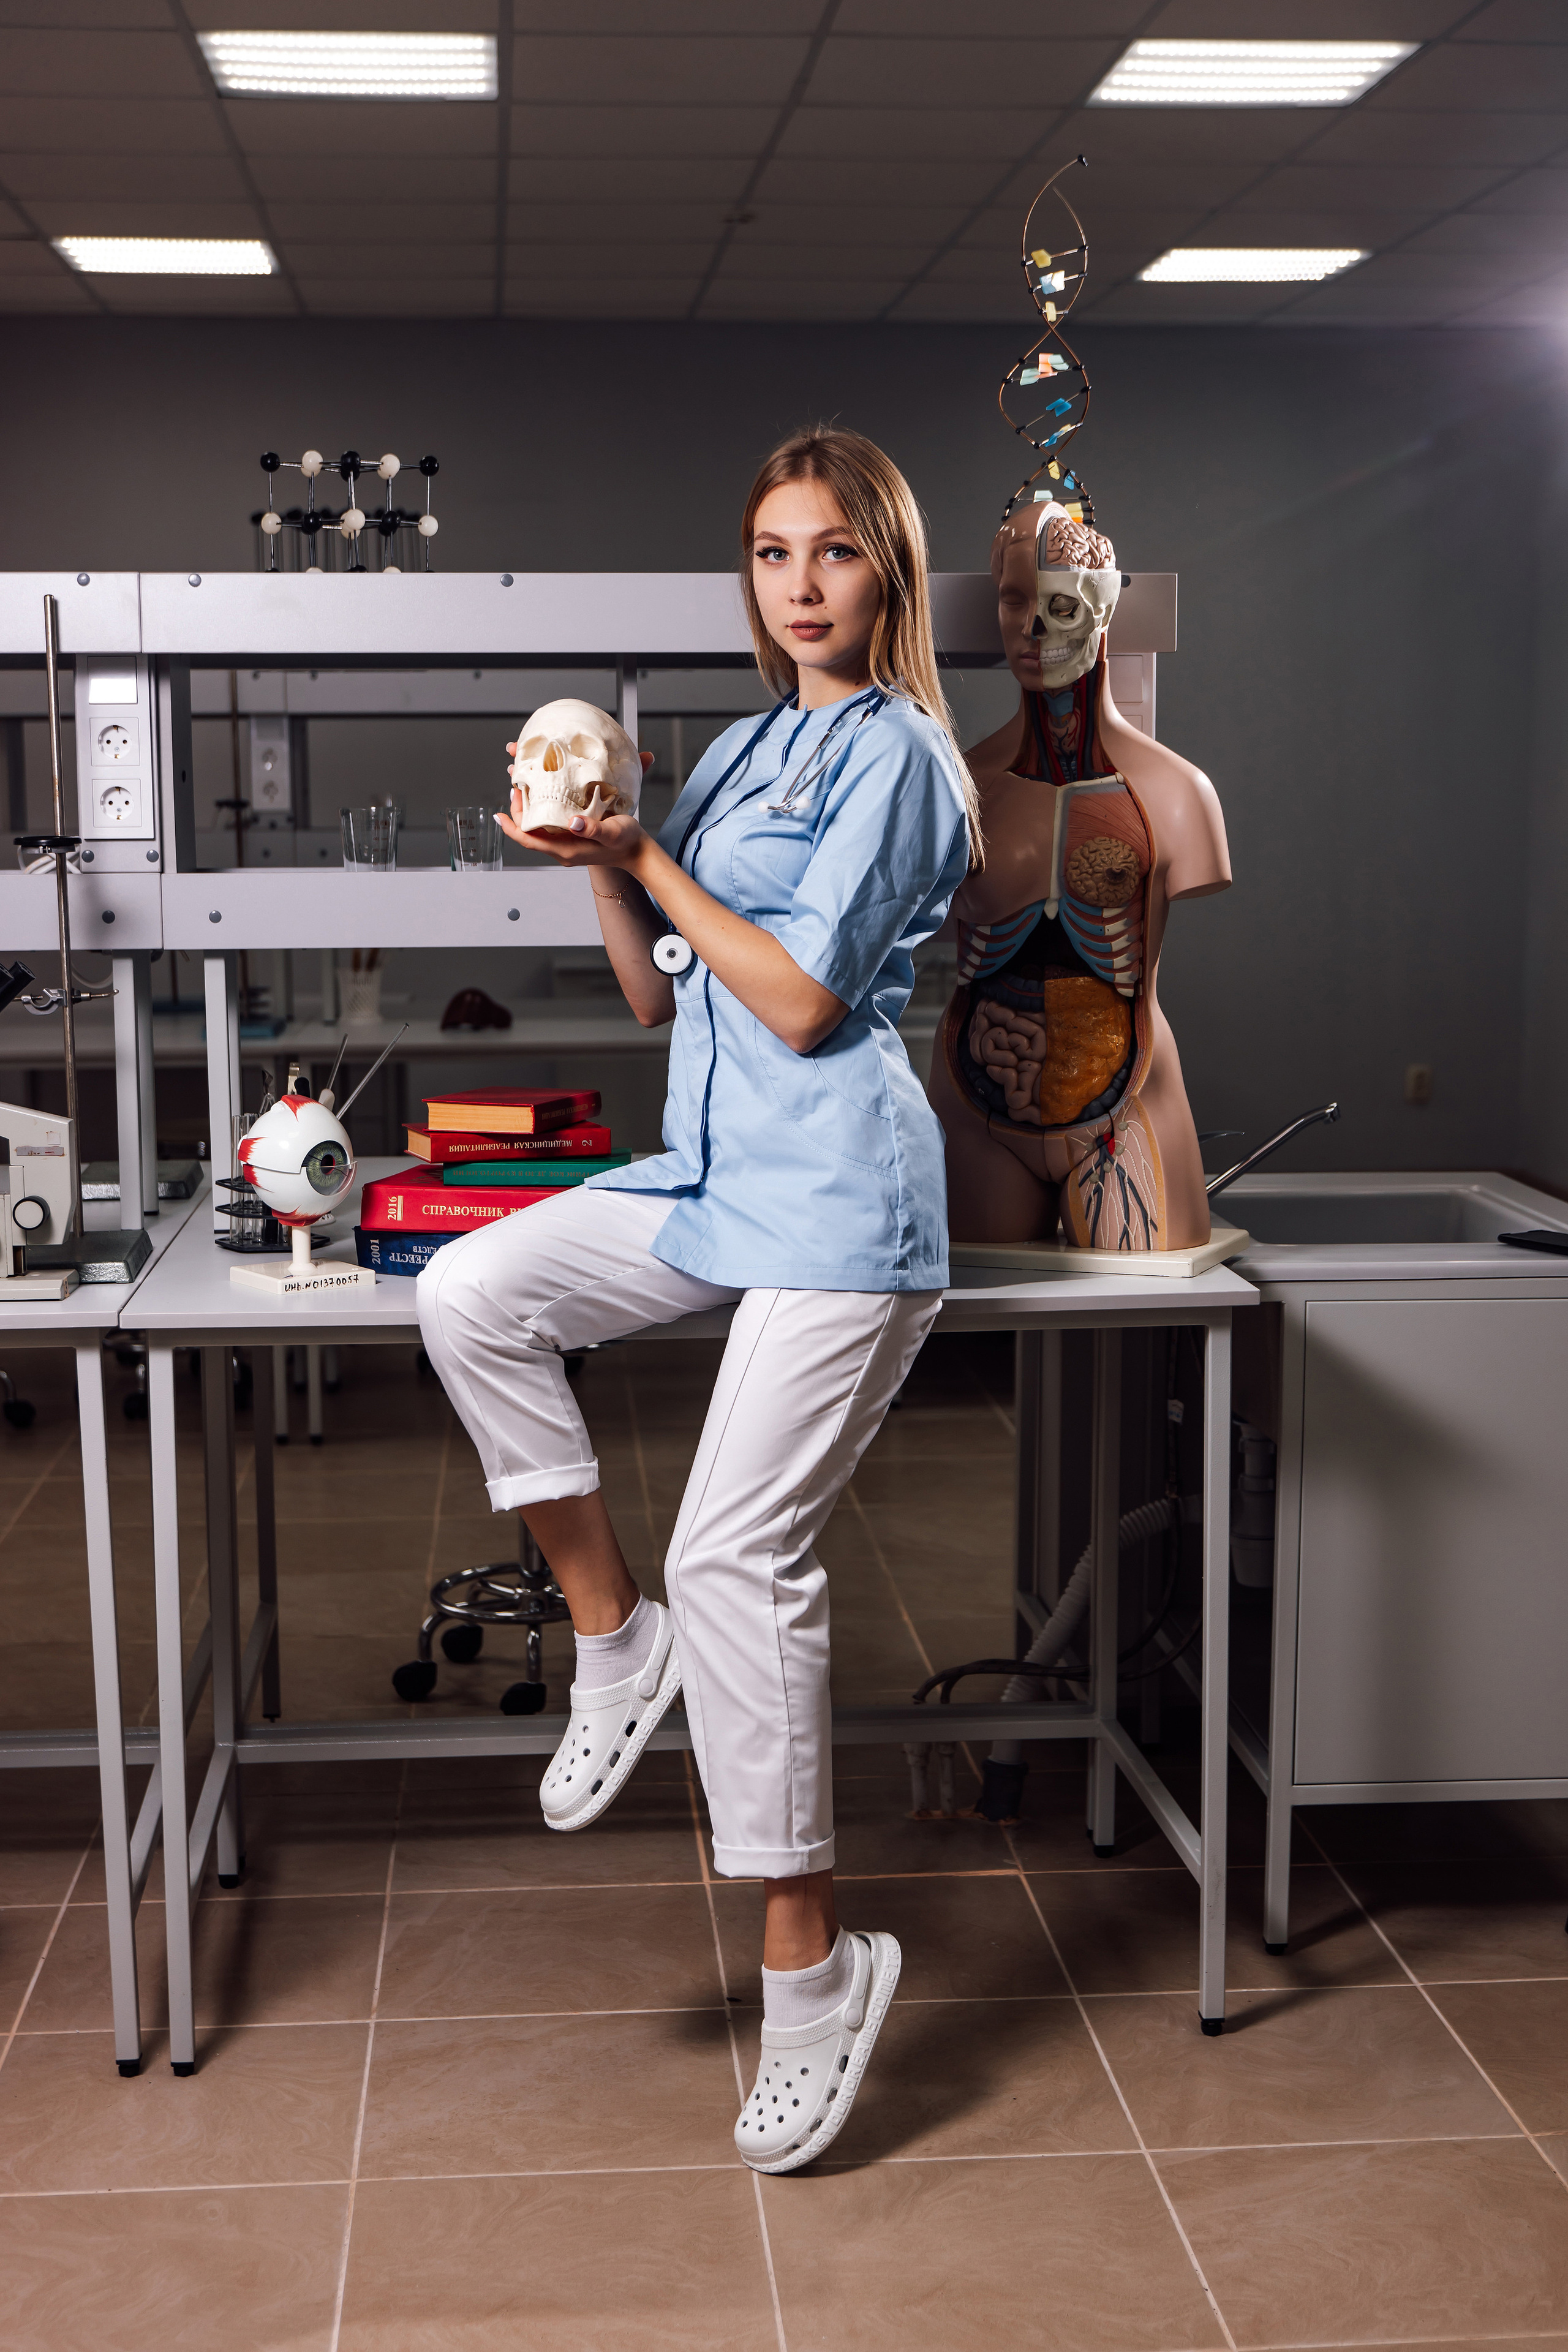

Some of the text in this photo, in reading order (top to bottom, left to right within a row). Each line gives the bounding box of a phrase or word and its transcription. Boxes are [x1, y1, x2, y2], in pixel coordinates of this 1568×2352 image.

[449, 1139, 573, 1152] МЕДИЦИНСКАЯ РЕАБИЛИТАЦИЯ
[388, 1196, 397, 1220] 2016
[422, 1205, 505, 1217] СПРАВОЧНИК
[370, 1238, 381, 1265] 2001
[389, 1252, 429, 1265] РЕЕСТР
[413, 1245, 440, 1254] ЕДСТВ
[601, 1755, 633, 1795] YOUR
[630, 1691, 671, 1755] DREAMS
[822, 2092, 853, 2136] YOUR
[843, 2019, 878, 2091] DREAMS
[867, 1970, 896, 2021] COME
